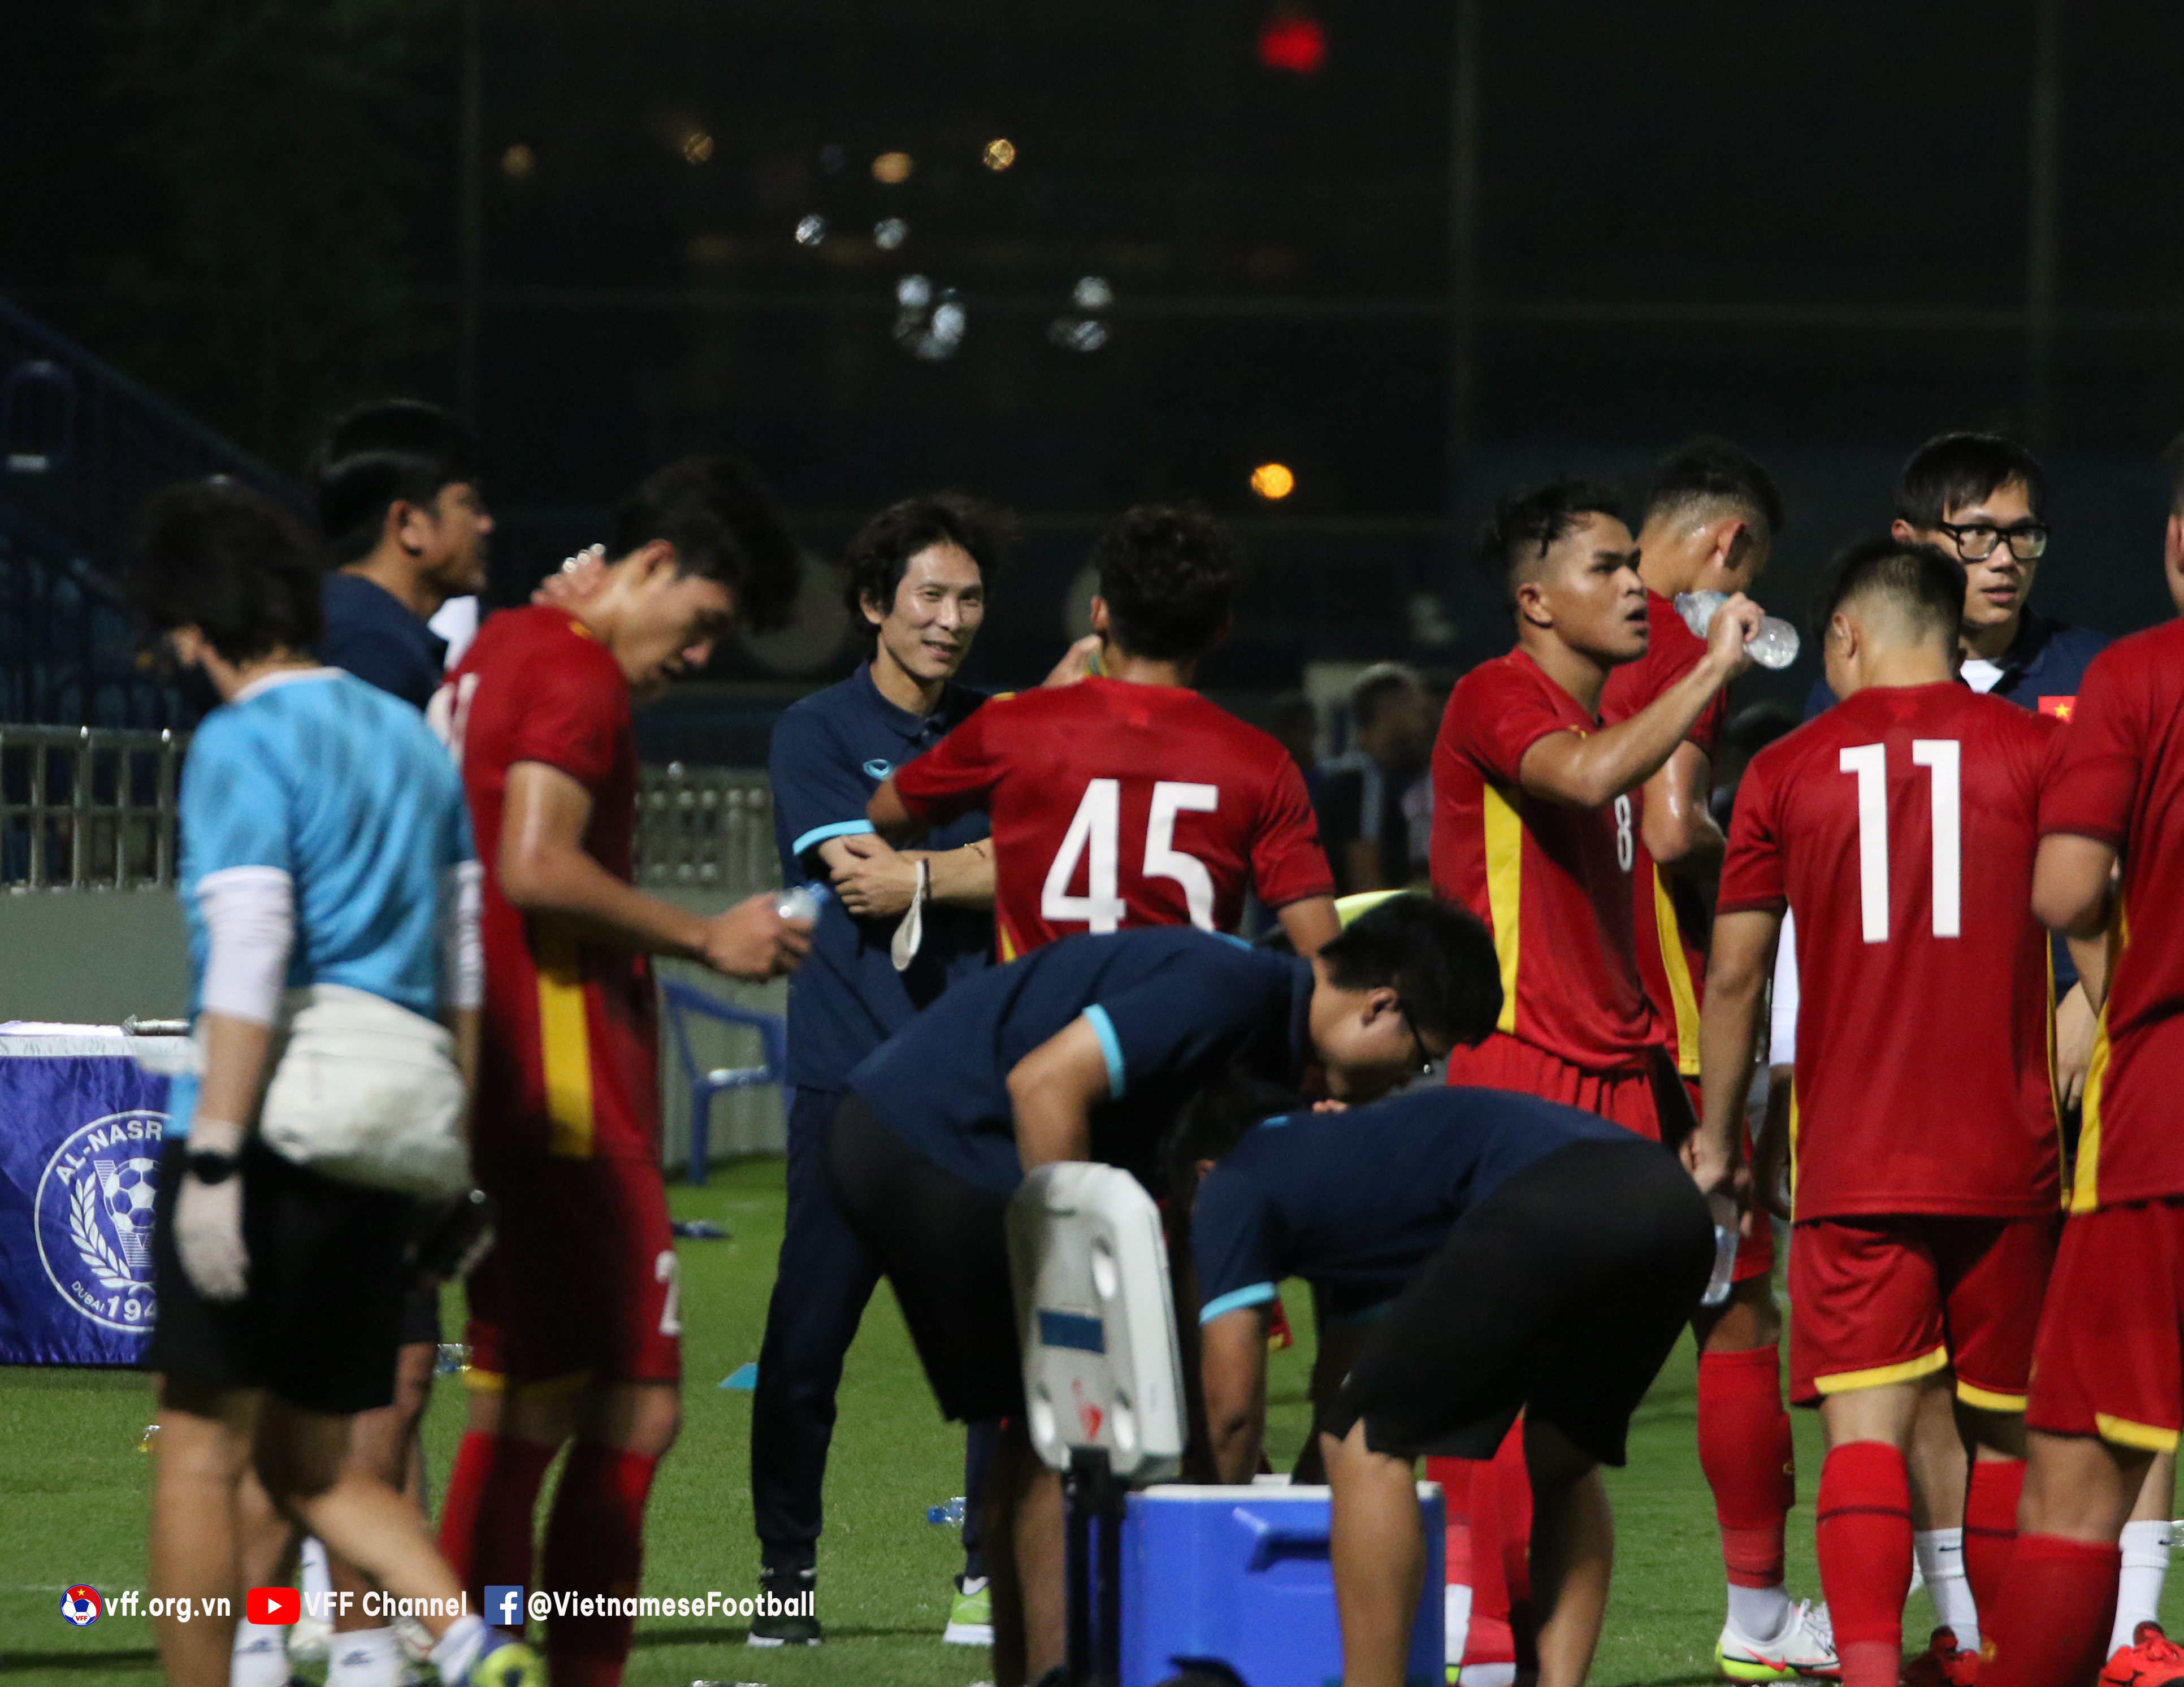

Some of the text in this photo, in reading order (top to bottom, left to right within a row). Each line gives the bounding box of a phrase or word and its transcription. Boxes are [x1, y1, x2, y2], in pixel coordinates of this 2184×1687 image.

[1041, 778, 1218, 934] 45
[1614, 794, 1633, 872] 8
[1839, 739, 1961, 943] 11
[55, 1120, 162, 1186] AL-NASR
[71, 1280, 105, 1312] DUBAI
